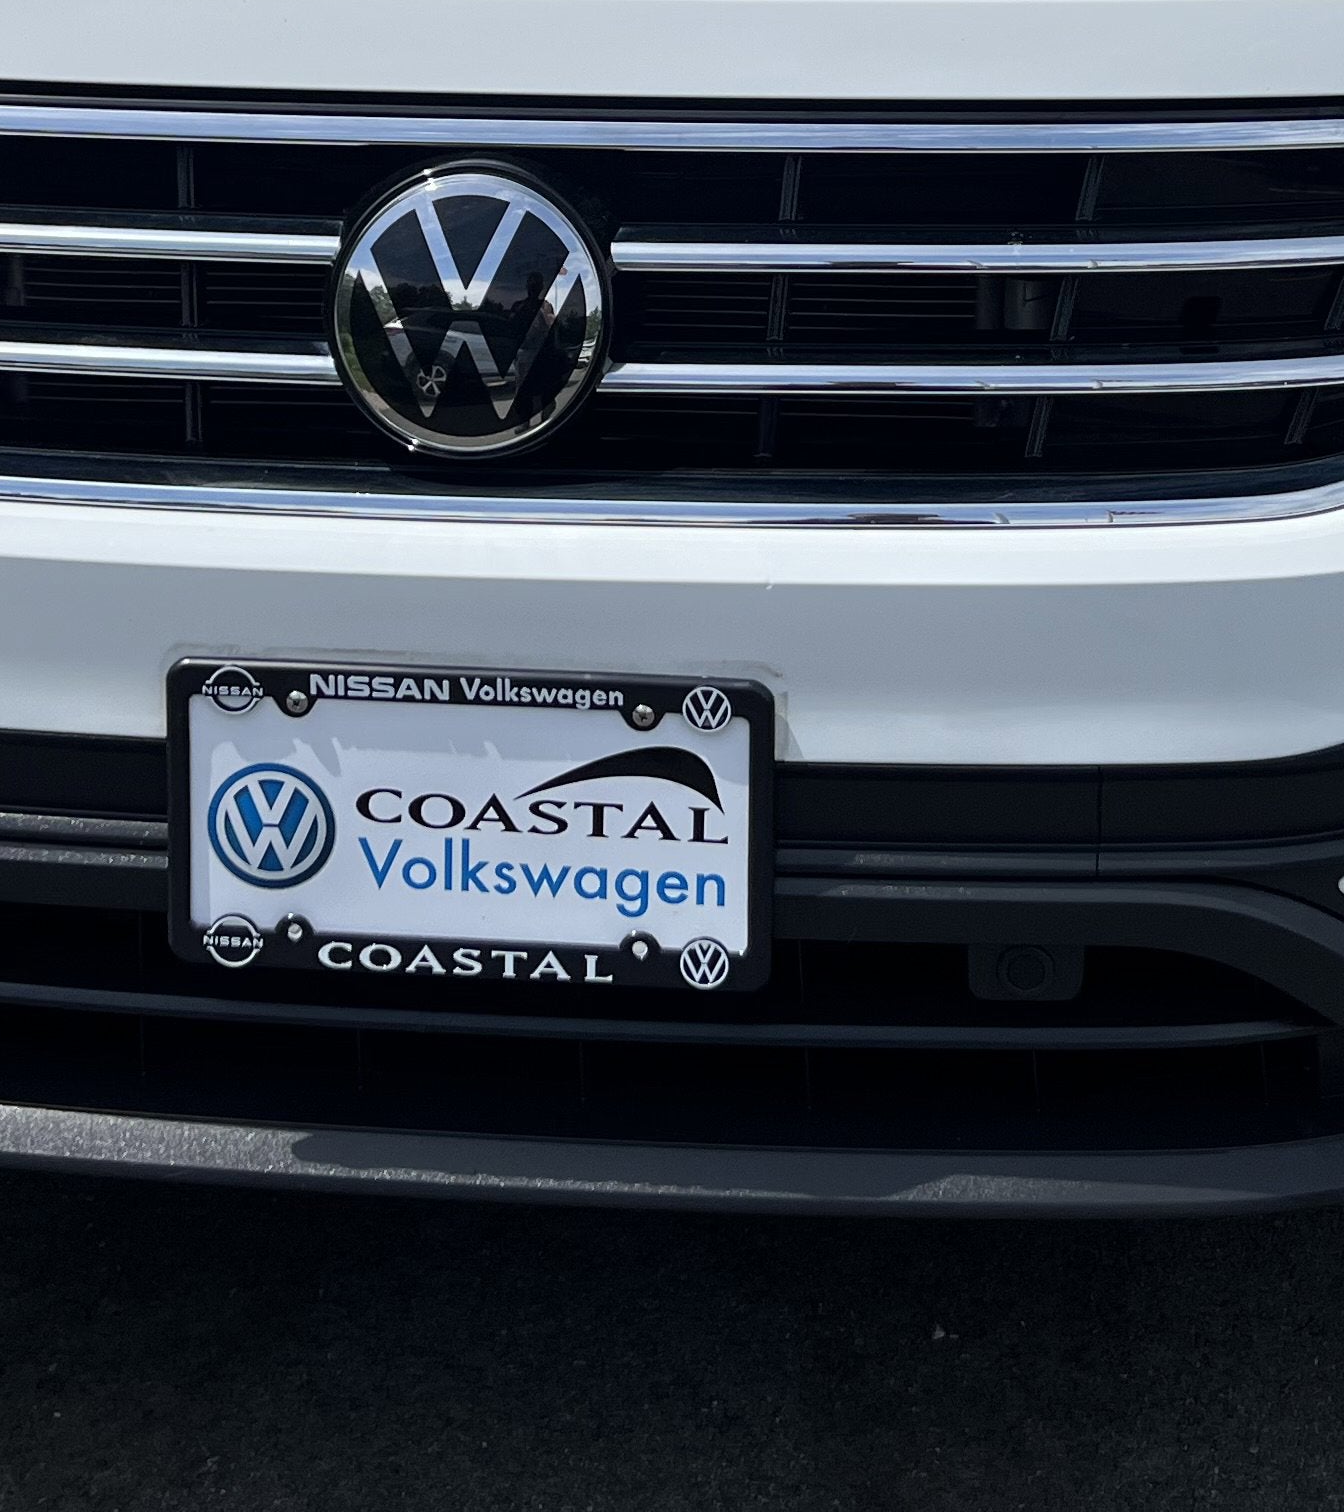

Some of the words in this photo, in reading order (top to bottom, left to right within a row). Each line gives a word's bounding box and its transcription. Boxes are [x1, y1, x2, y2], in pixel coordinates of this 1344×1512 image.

[344, 180, 594, 434] VW
[202, 682, 264, 698] NISSAN
[309, 673, 450, 702] NISSAN
[459, 676, 624, 709] Volkswagen
[685, 690, 729, 730] VW
[216, 770, 329, 881] VW
[355, 788, 729, 845] COASTAL
[358, 837, 727, 918] Volkswagen
[202, 934, 264, 950] NISSAN
[317, 941, 613, 983] COASTAL
[683, 942, 727, 985] VW
